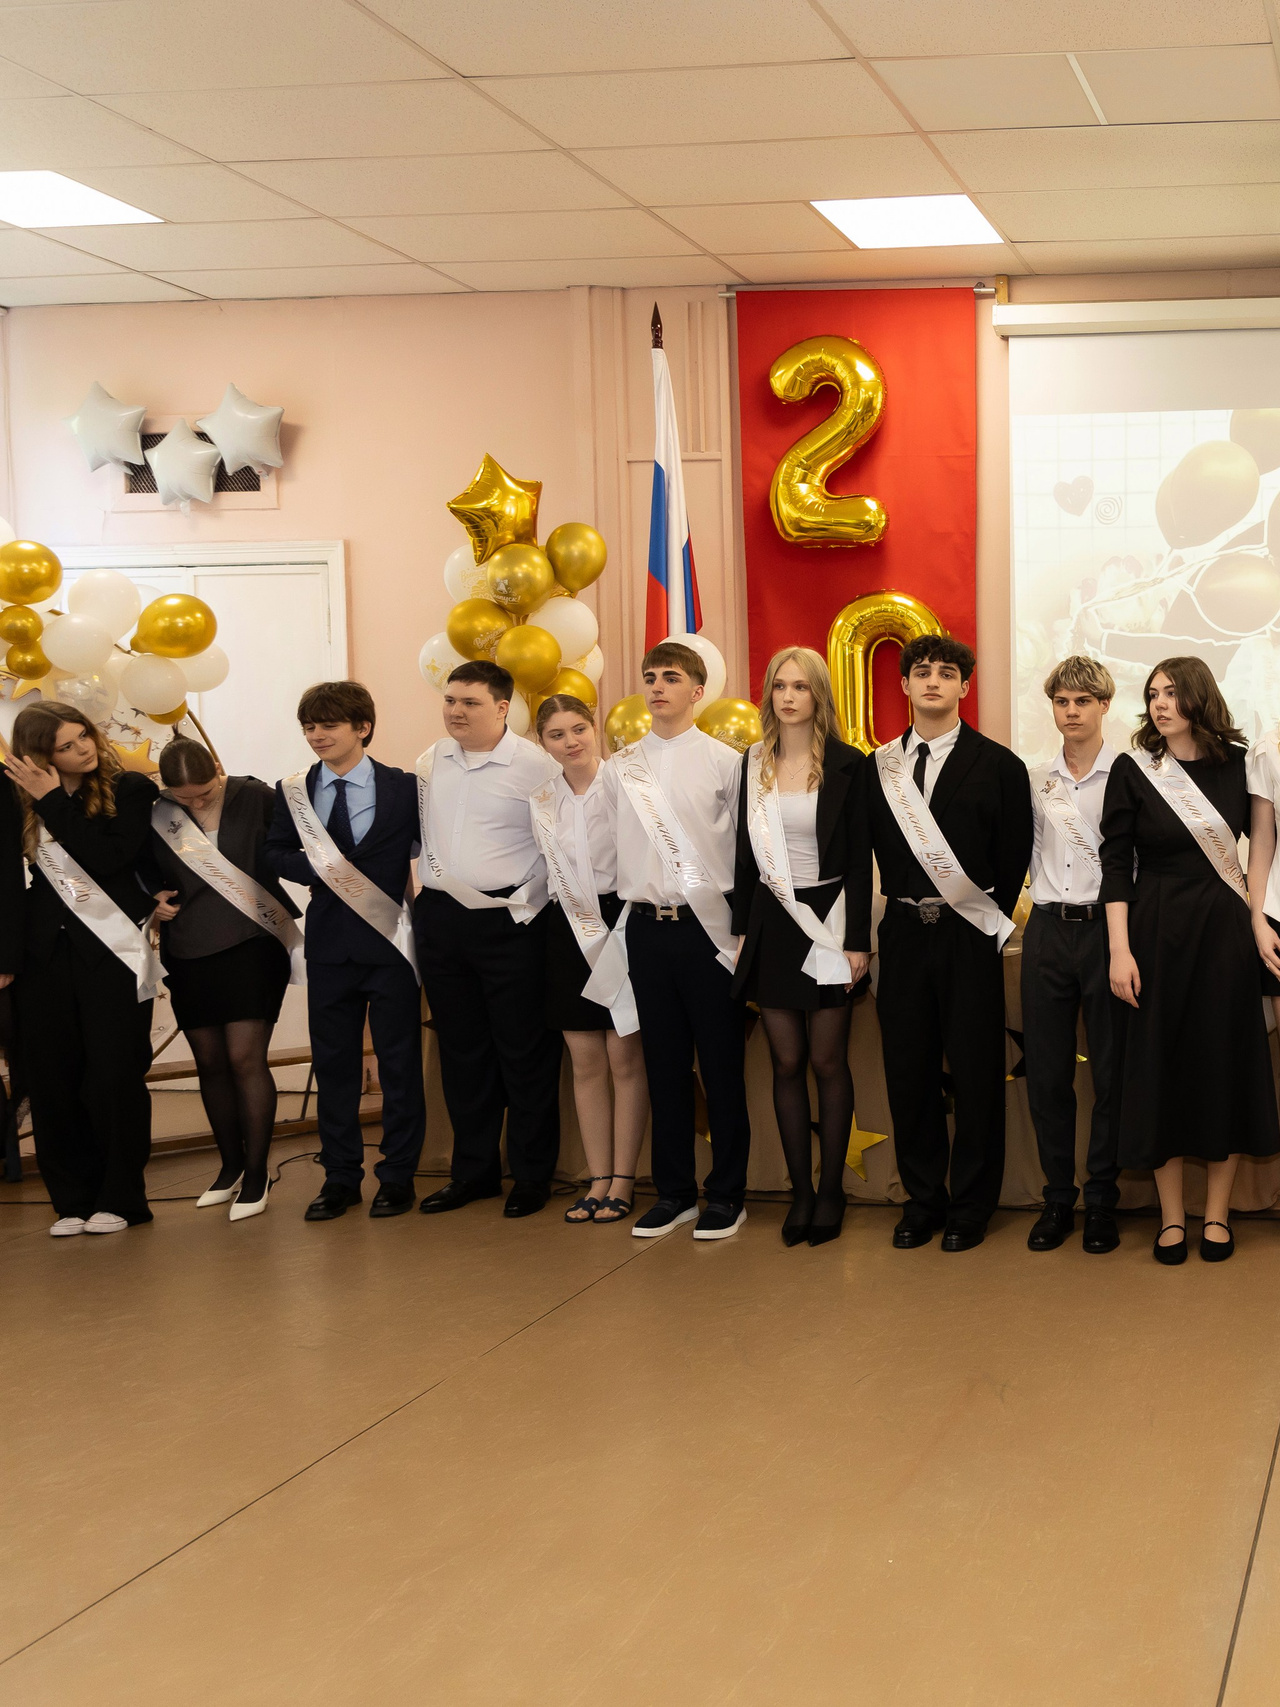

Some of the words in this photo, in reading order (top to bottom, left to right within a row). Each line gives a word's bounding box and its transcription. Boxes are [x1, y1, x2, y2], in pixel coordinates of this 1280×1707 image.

[769, 334, 890, 549] 2
[426, 851, 445, 878] 2026
[536, 811, 581, 908] Выпускница
[574, 910, 606, 938] 2026
[624, 763, 682, 858] Выпускник
[675, 859, 710, 889] 2026
[882, 756, 932, 849] Выпускник
[923, 850, 959, 879] 2026
[1163, 774, 1229, 864] Выпускница
[1224, 862, 1245, 889] 2026
[333, 873, 372, 898] 2026
